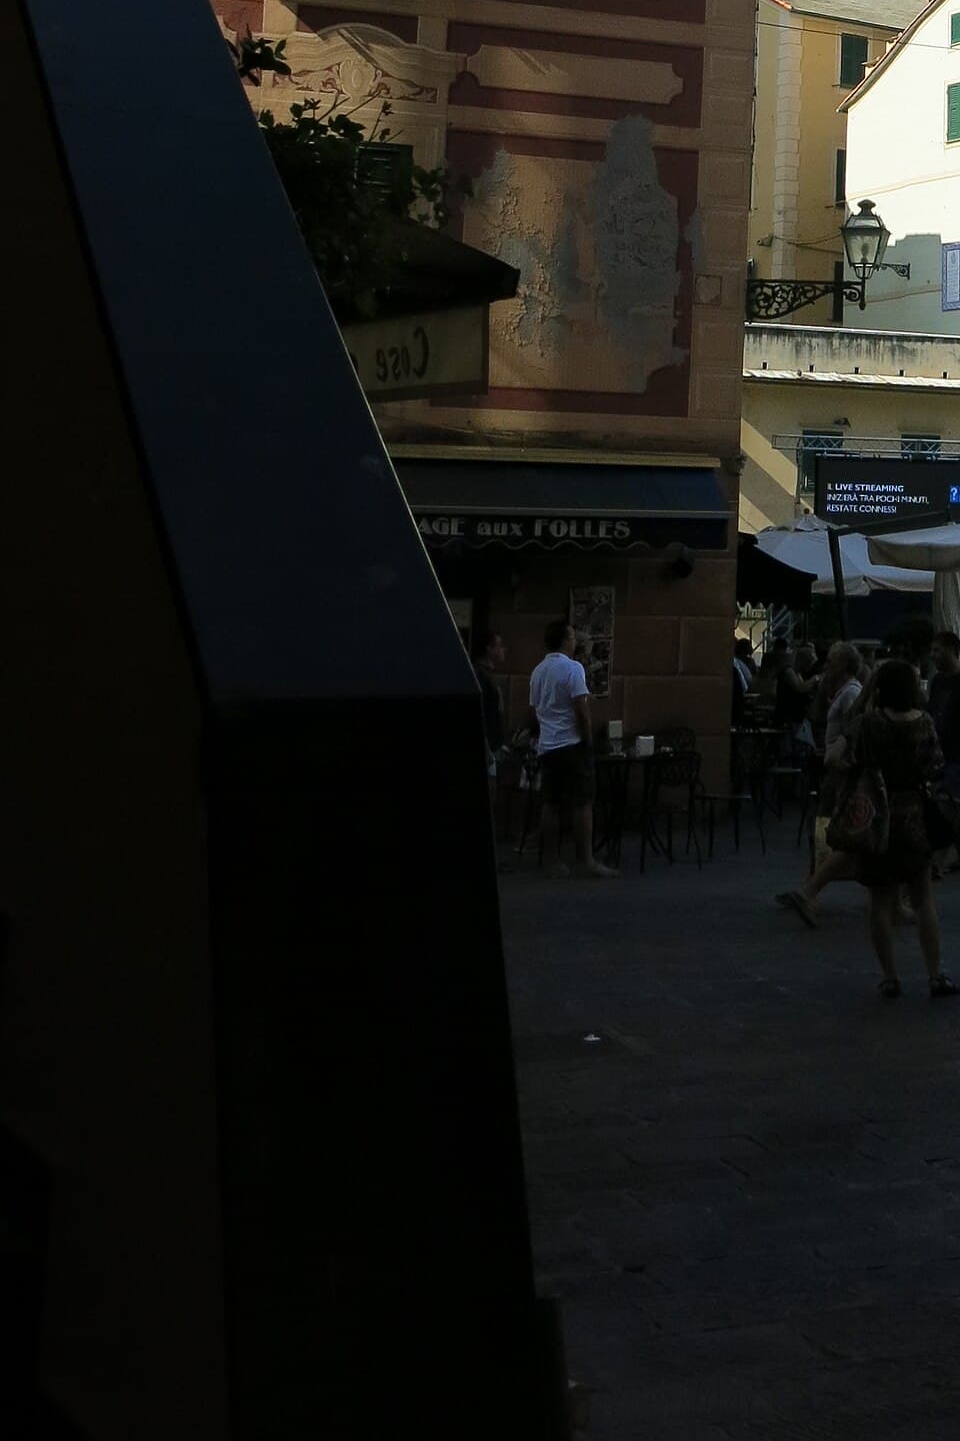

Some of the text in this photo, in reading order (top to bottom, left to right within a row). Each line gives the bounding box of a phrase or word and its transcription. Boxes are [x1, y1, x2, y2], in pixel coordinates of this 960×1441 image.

[835, 483, 854, 491] LIVE
[855, 484, 905, 493] STREAMING
[859, 494, 875, 503] TRA
[875, 494, 900, 503] POCHI
[826, 504, 858, 513] RESTATE
[477, 520, 524, 537] aux
[533, 518, 632, 539] FOLLES
